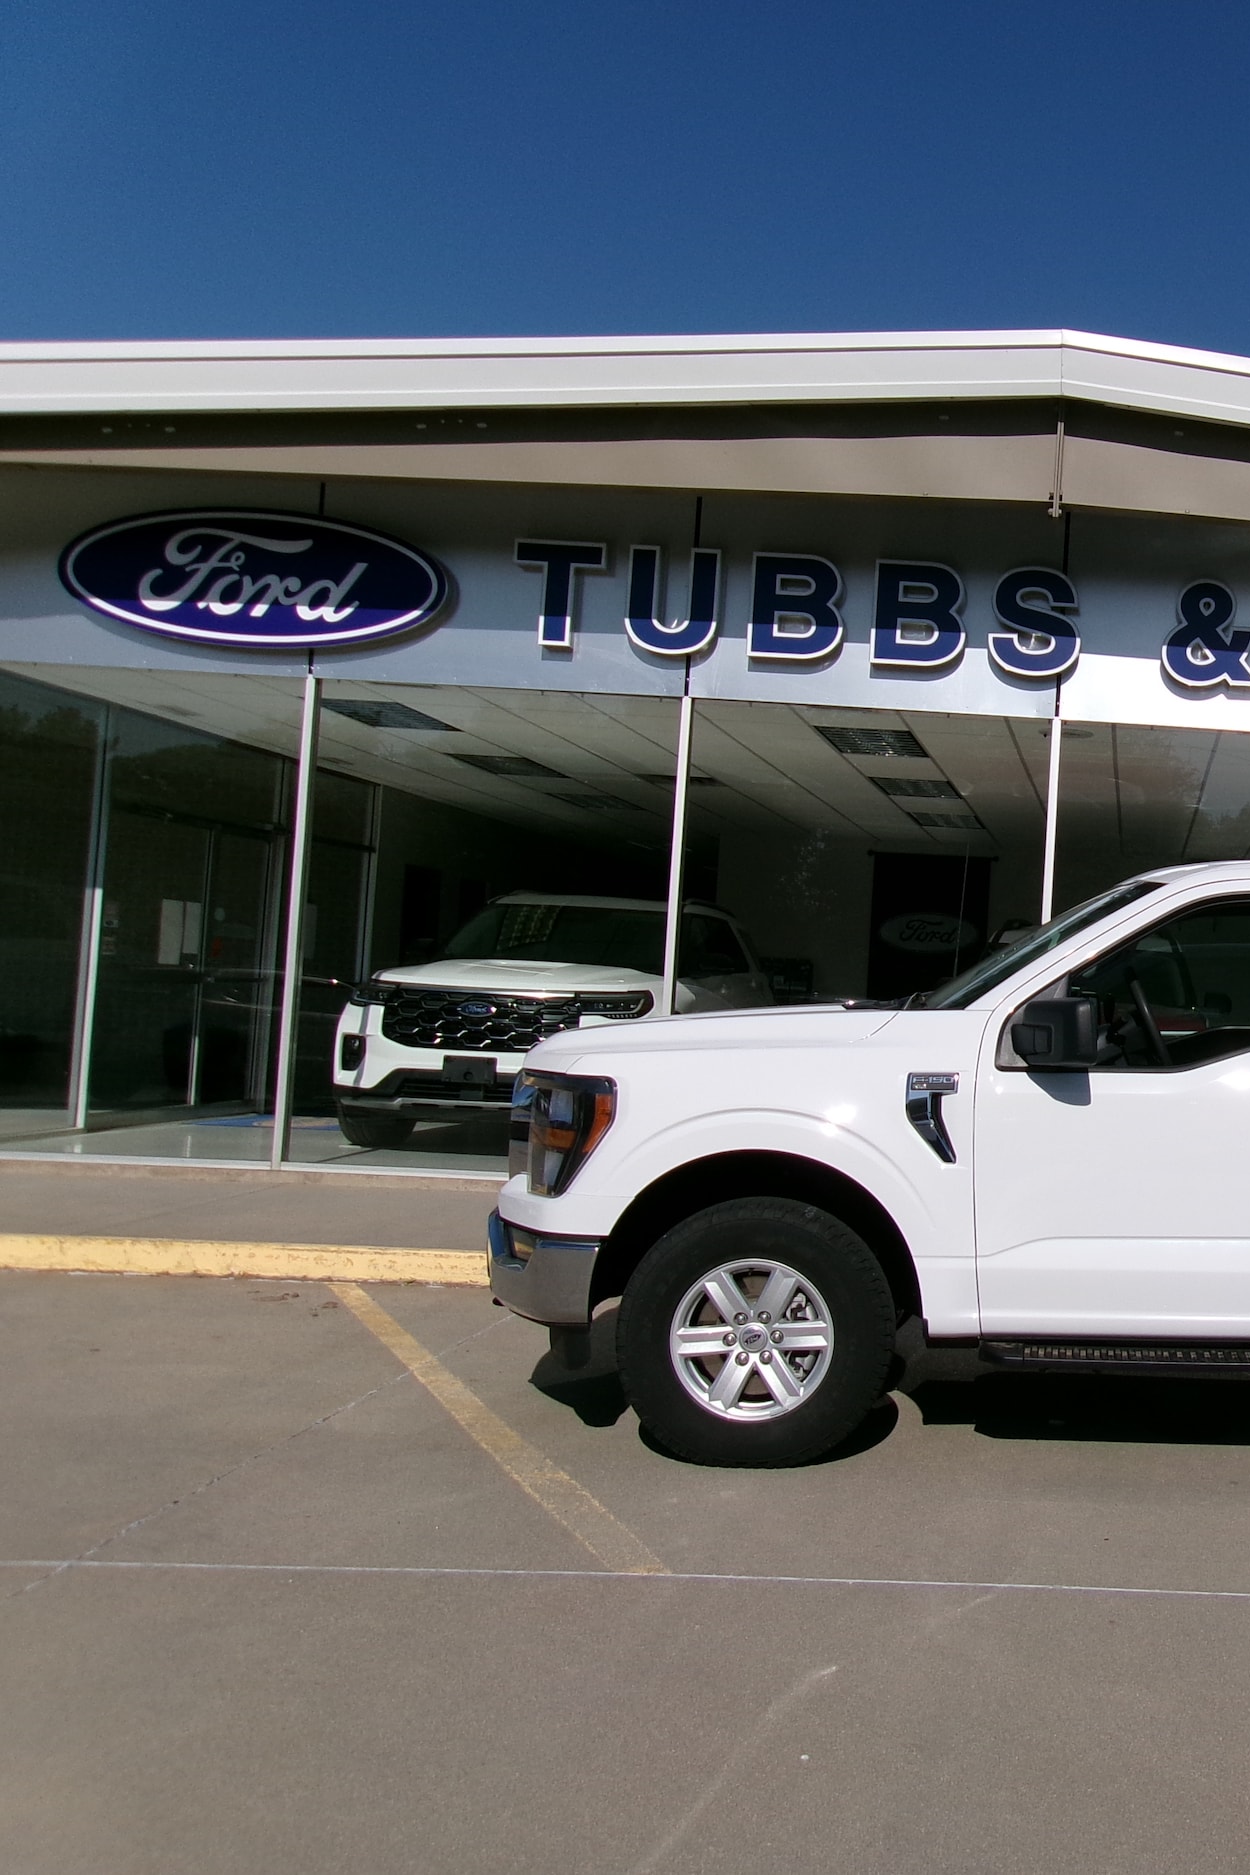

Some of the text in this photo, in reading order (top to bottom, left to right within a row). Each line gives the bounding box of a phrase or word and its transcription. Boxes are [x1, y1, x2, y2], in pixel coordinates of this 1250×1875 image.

[138, 527, 368, 623] Ford
[514, 539, 1082, 676] TUBBS
[899, 919, 958, 944] Ford
[912, 1076, 954, 1084] F-150
